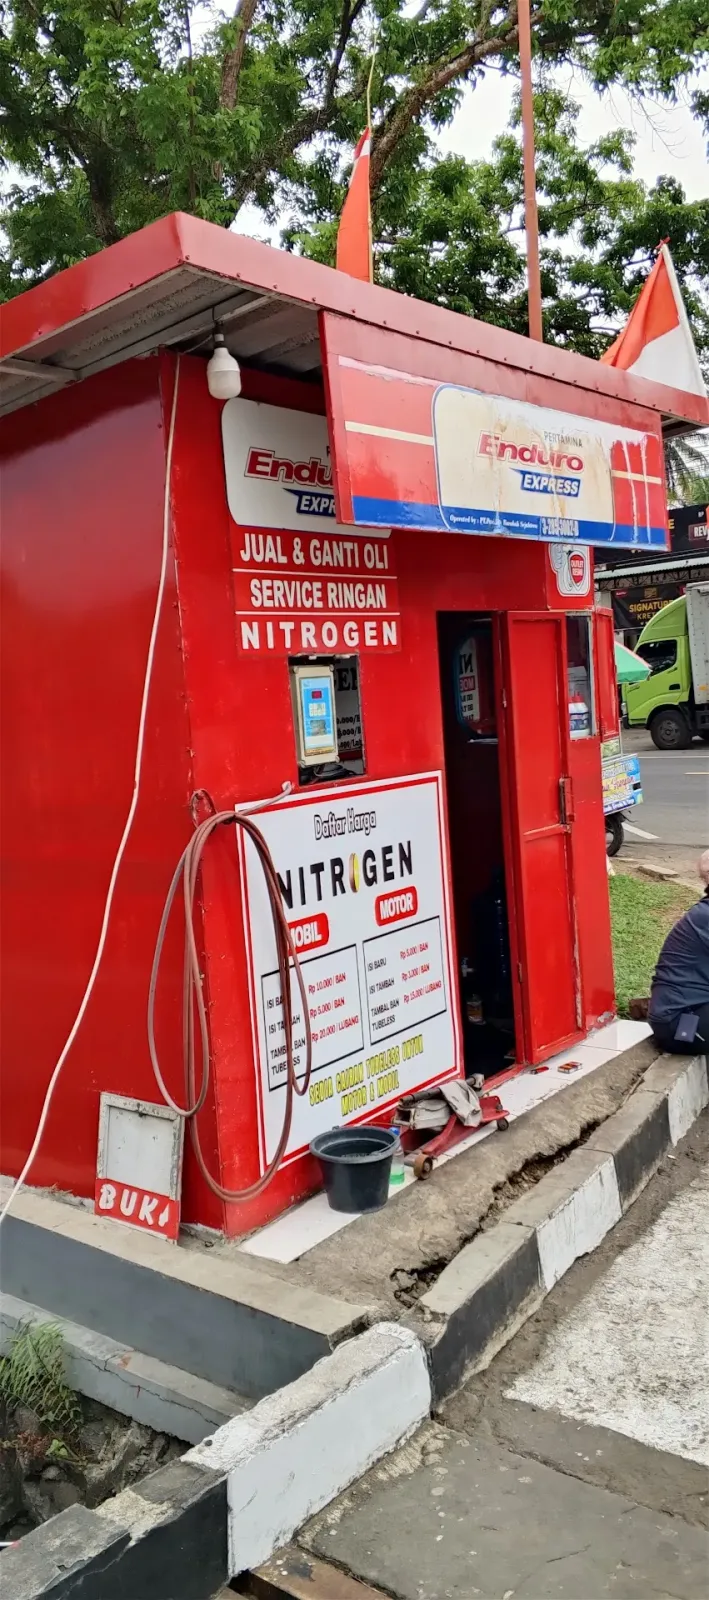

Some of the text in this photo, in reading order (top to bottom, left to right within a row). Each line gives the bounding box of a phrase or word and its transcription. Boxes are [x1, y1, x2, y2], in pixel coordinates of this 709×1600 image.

[543, 431, 583, 448] PERTAMINA
[477, 430, 584, 474] Enduro
[244, 446, 334, 489] Endu
[523, 474, 579, 495] EXPRESS
[300, 495, 336, 514] EXPR
[693, 525, 707, 537] REV
[240, 533, 389, 569] JUAL & GANTI OLI
[250, 578, 386, 609] SERVICE RINGAN
[629, 600, 674, 613] SIGNATUR
[637, 612, 656, 620] KRET
[240, 620, 397, 649] NITROGEN
[314, 808, 376, 840] Daftar Harga
[380, 892, 414, 920] MOTOR
[400, 951, 406, 960] Rp
[420, 942, 428, 952] BAN
[374, 958, 386, 970] BARU
[402, 972, 408, 982] Rp
[420, 963, 430, 974] BAN
[308, 984, 316, 996] Rp
[316, 977, 332, 990] 10.000
[335, 972, 346, 984] BAN
[376, 977, 394, 992] TAMBAH
[404, 994, 410, 1004] Rp
[425, 980, 442, 993] LUBANG
[276, 996, 284, 1006] BA
[310, 1008, 318, 1019] Rp
[318, 1002, 332, 1014] 5.000
[334, 997, 345, 1008] BAN
[371, 998, 400, 1017] TAMBAL BAN
[268, 1014, 300, 1035] ISI TAAH
[312, 1032, 318, 1043] Rp
[319, 1024, 336, 1039] 20.000
[338, 1015, 359, 1031] LUBANG
[372, 1014, 396, 1032] TUBELESS
[270, 1037, 306, 1060] TAMB BAN
[272, 1056, 300, 1076] TUBESS
[309, 1076, 334, 1106] SEDIA
[366, 1045, 400, 1079] TUBELESS
[402, 1034, 424, 1062] UNTUK
[340, 1085, 367, 1116] MOTOR
[377, 1069, 400, 1098] MOBIL
